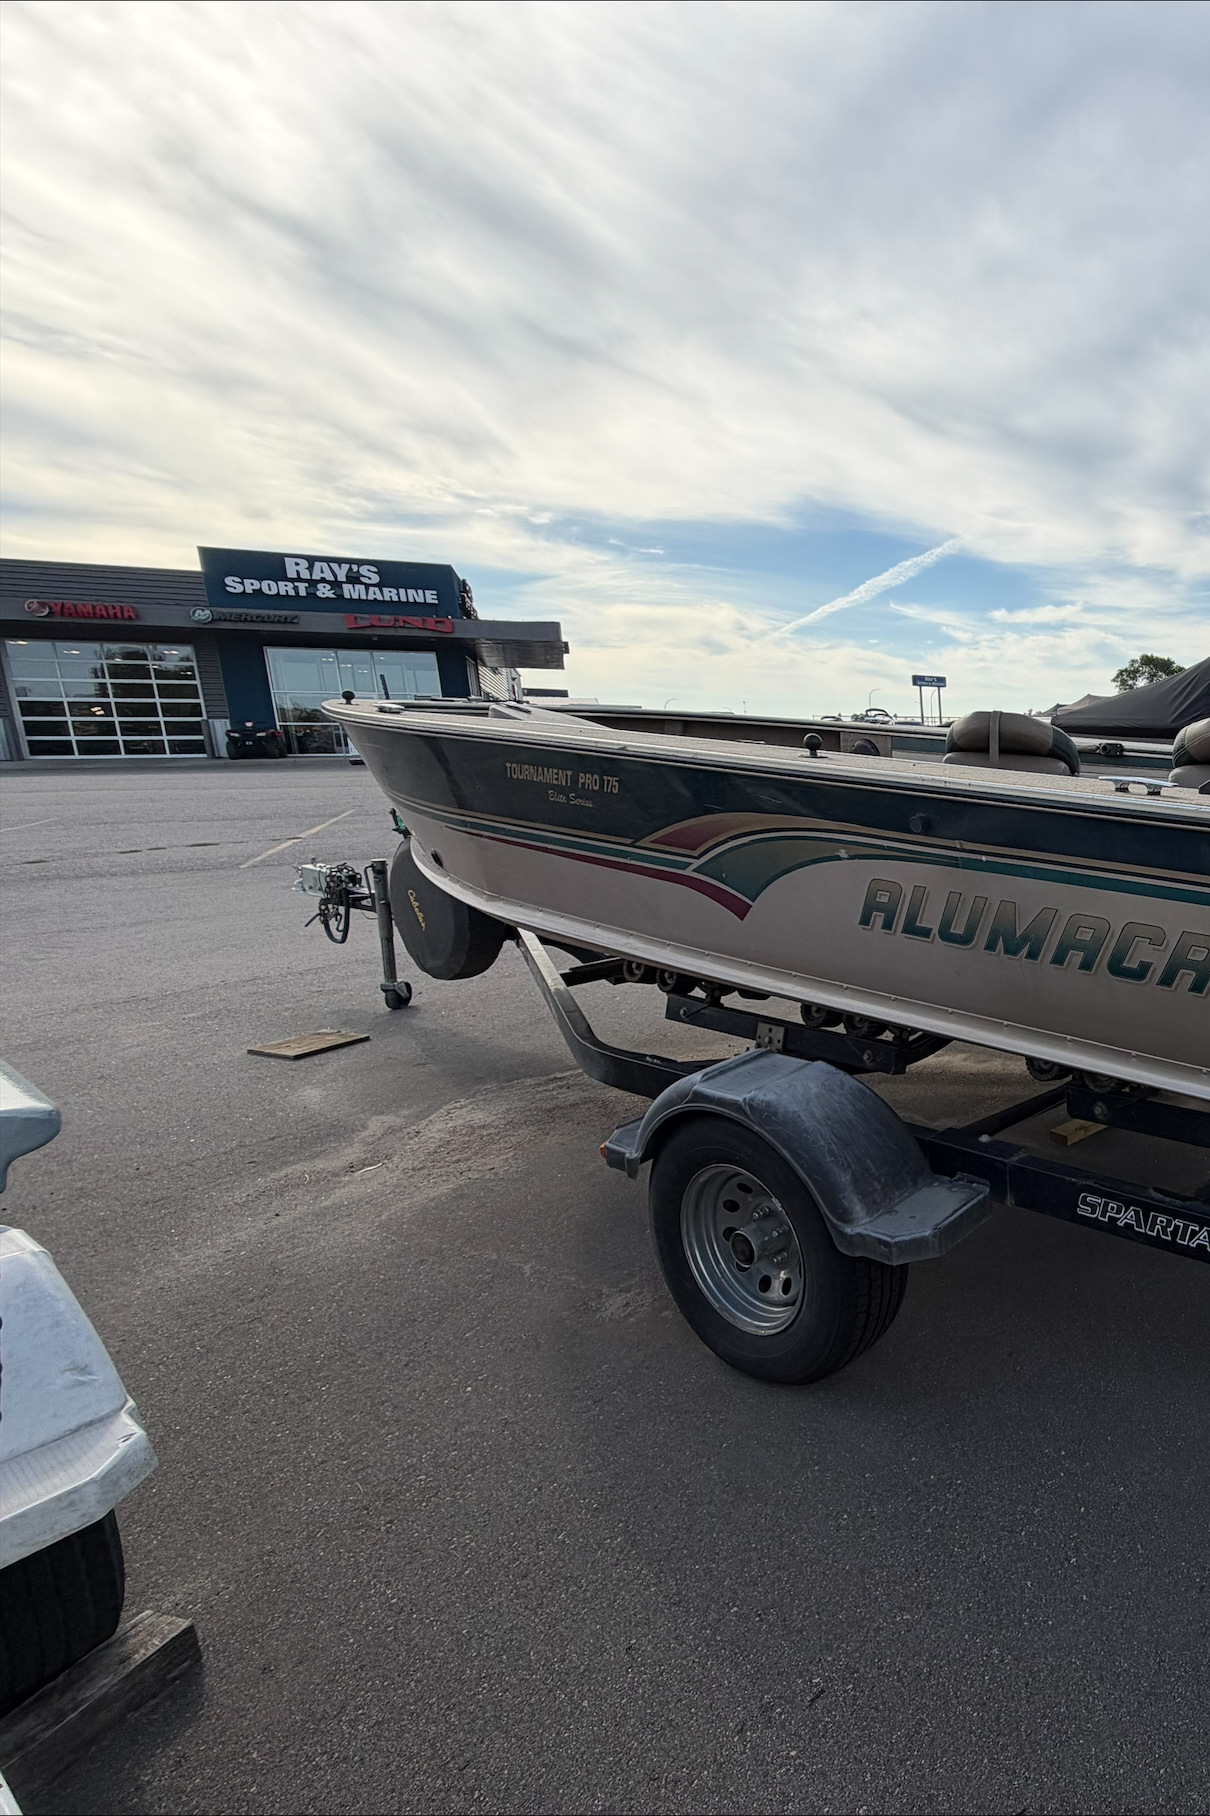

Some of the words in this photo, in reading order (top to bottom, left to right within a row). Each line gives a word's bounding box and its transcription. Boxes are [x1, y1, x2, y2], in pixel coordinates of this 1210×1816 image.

[283, 556, 381, 585] RAY'S
[223, 575, 309, 597] SPORT
[315, 583, 337, 599] &
[342, 583, 439, 605] MARINE
[49, 600, 138, 620] YAMAHA
[214, 611, 299, 625] MERCURY
[344, 613, 455, 634] LUND
[505, 762, 573, 787] TOURNAMENT
[578, 772, 600, 791] PRO
[602, 775, 619, 794] 175
